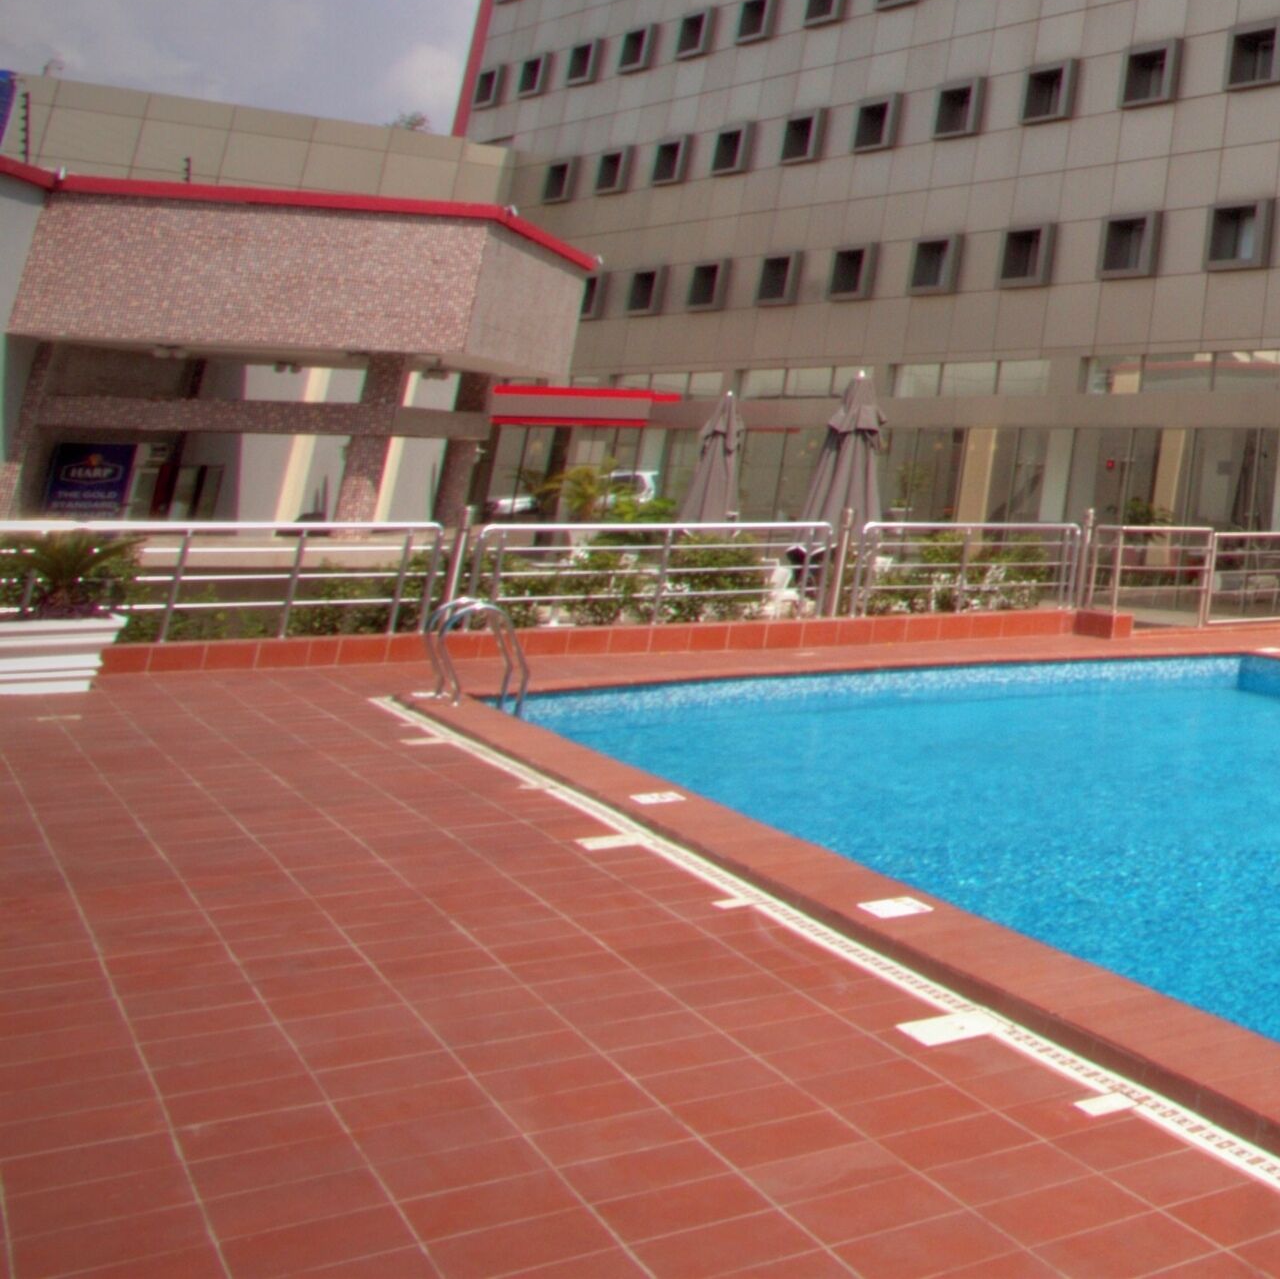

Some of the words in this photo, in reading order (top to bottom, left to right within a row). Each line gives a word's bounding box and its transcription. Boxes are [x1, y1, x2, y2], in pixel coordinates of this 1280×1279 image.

[70, 466, 113, 478] HARP
[58, 490, 80, 499] THE
[82, 490, 118, 499] GOLD
